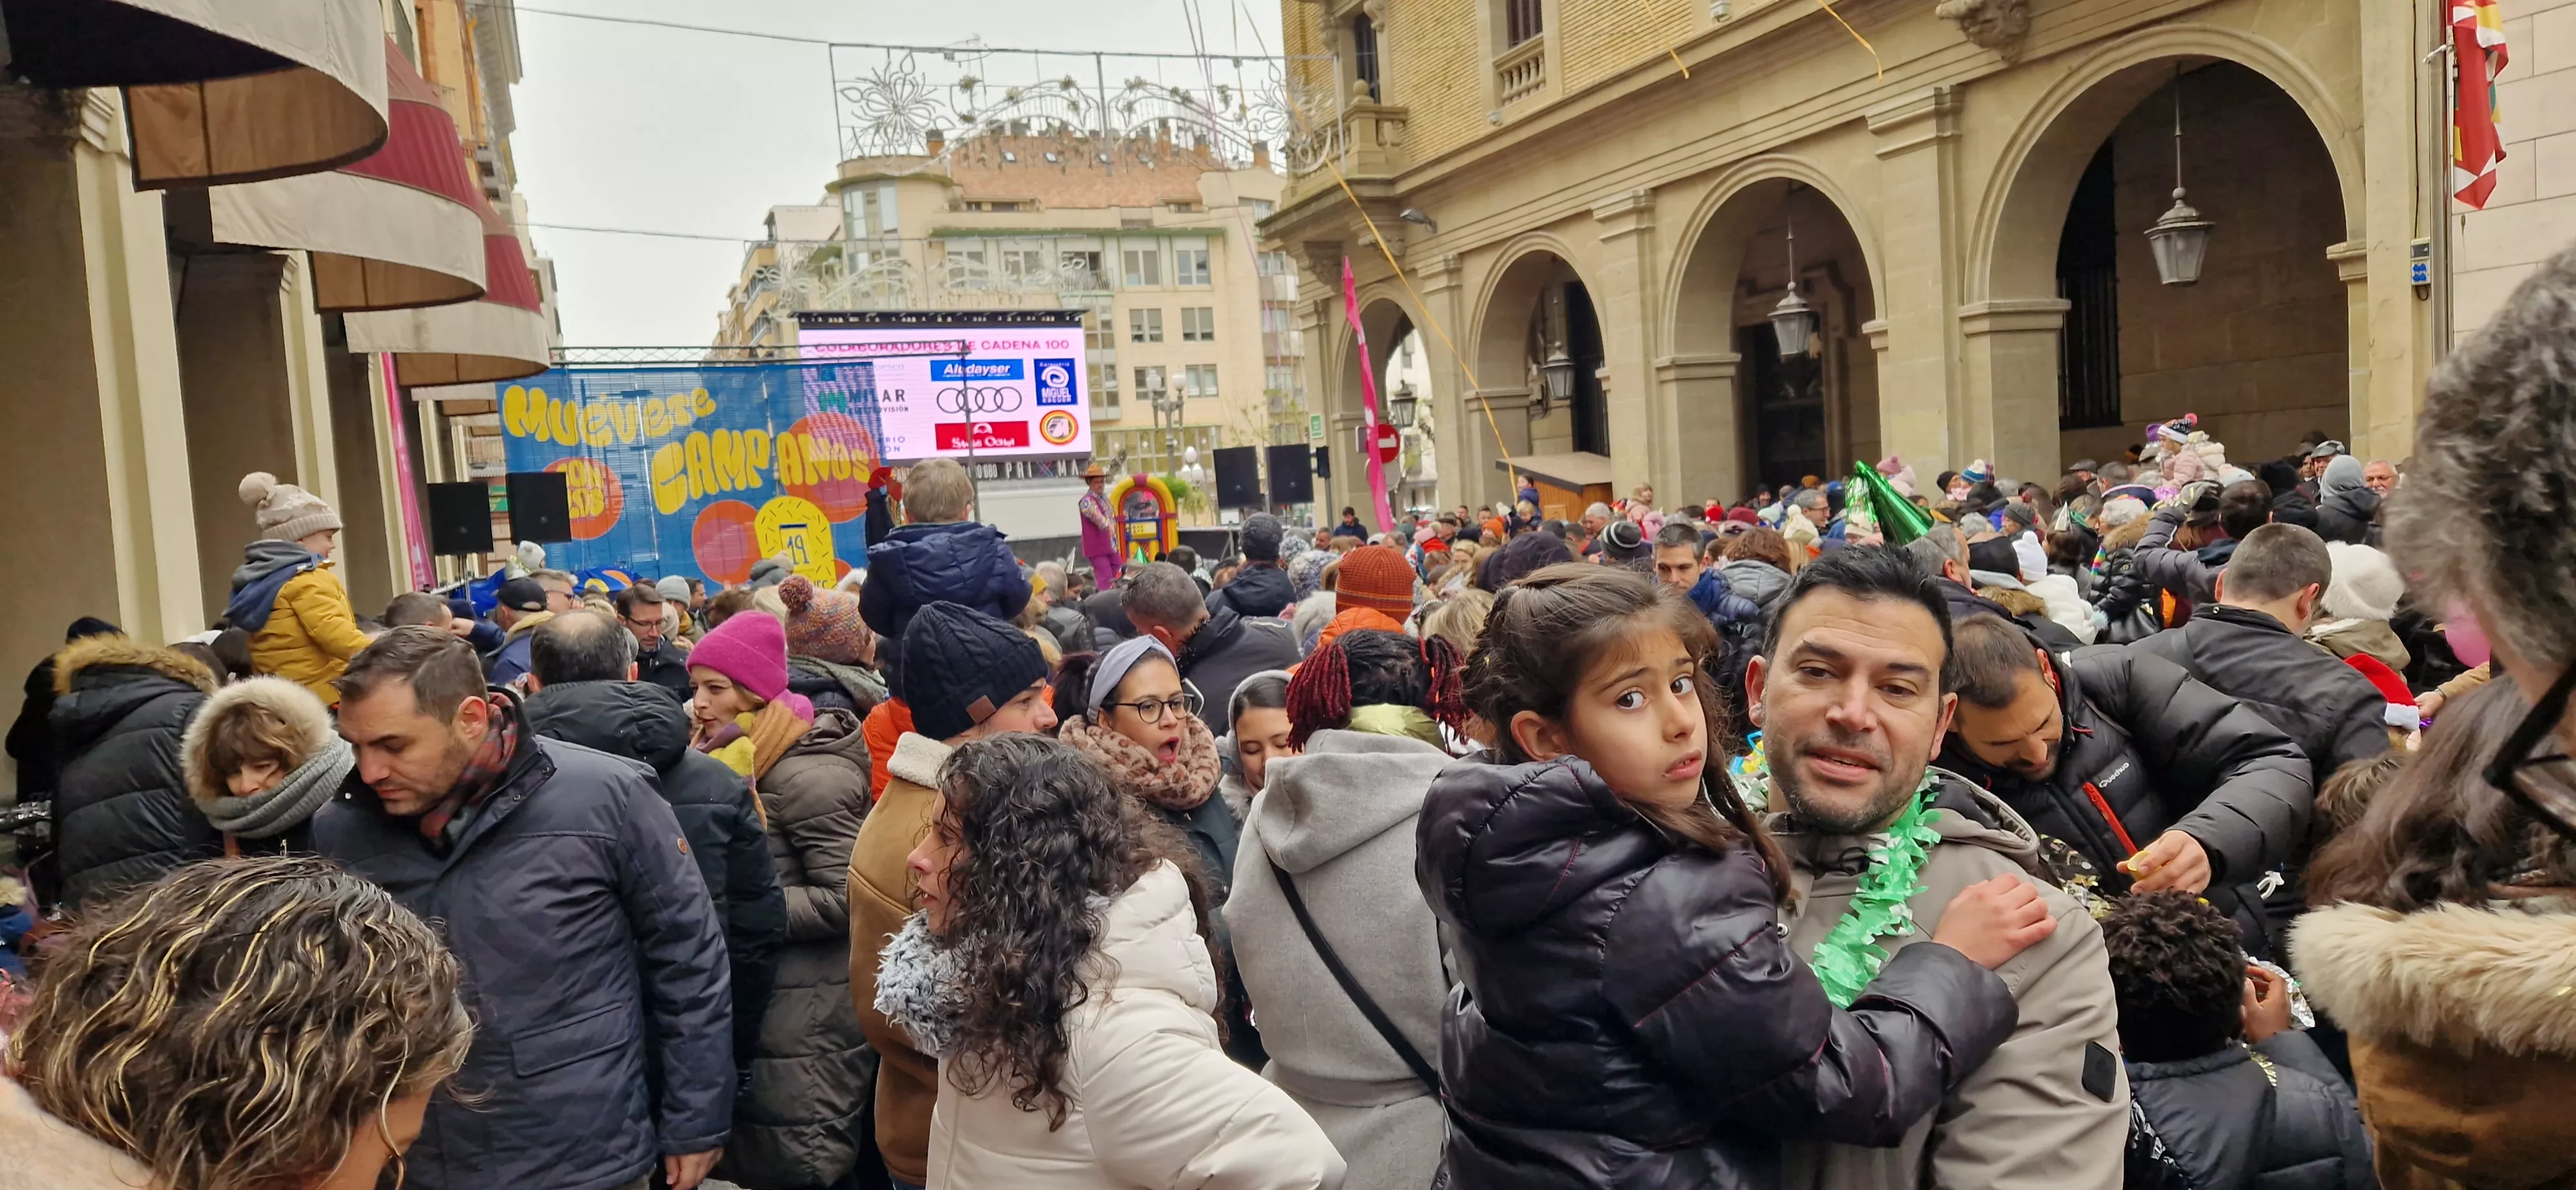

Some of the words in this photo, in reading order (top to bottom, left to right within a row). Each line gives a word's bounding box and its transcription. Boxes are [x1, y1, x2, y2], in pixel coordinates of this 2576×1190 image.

[981, 341, 1039, 350] CADENA
[1046, 340, 1070, 350] 100
[1041, 388, 1071, 398] MIGUEL
[787, 534, 810, 565] 19
